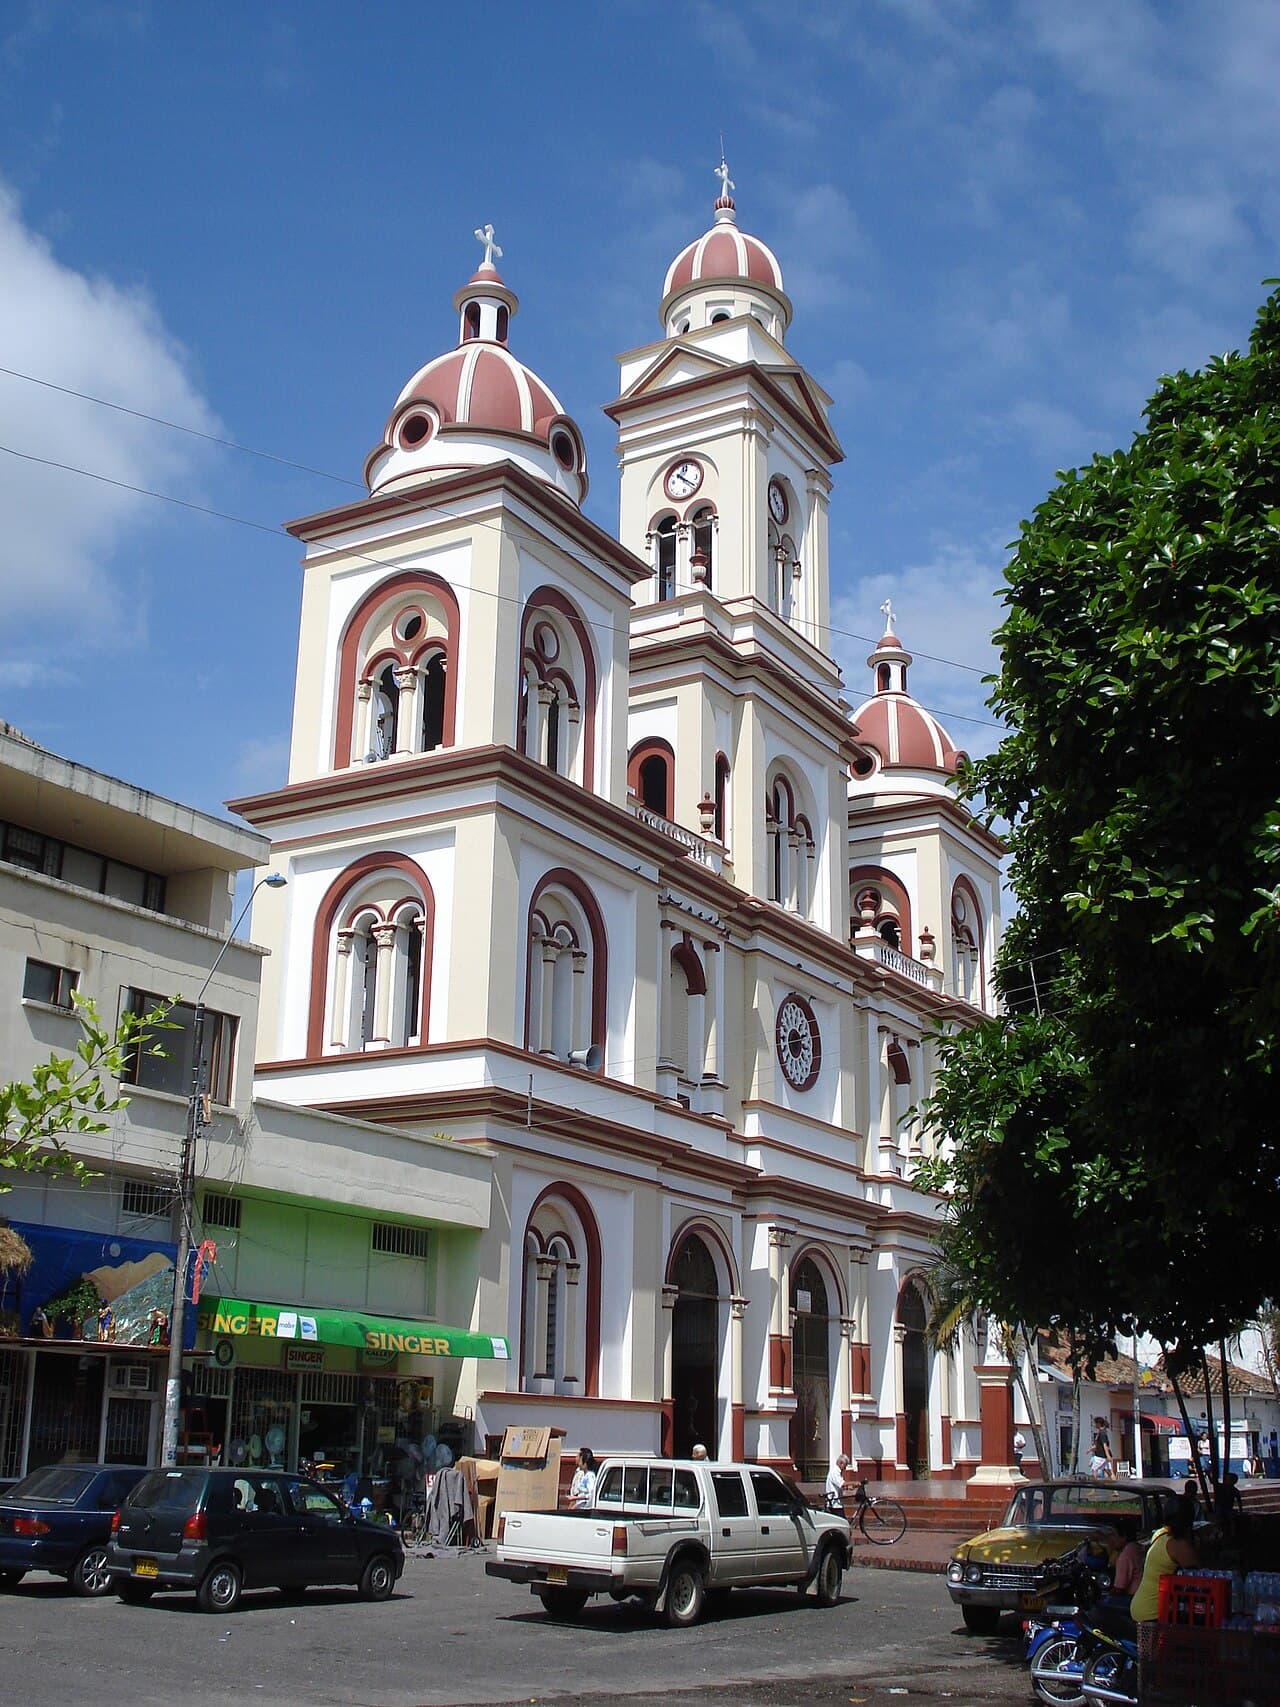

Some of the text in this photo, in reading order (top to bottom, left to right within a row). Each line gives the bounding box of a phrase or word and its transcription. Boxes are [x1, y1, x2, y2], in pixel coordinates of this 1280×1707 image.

[197, 1312, 277, 1337] SINGER
[365, 1331, 451, 1356] SINGER
[289, 1350, 324, 1363] SINGER
